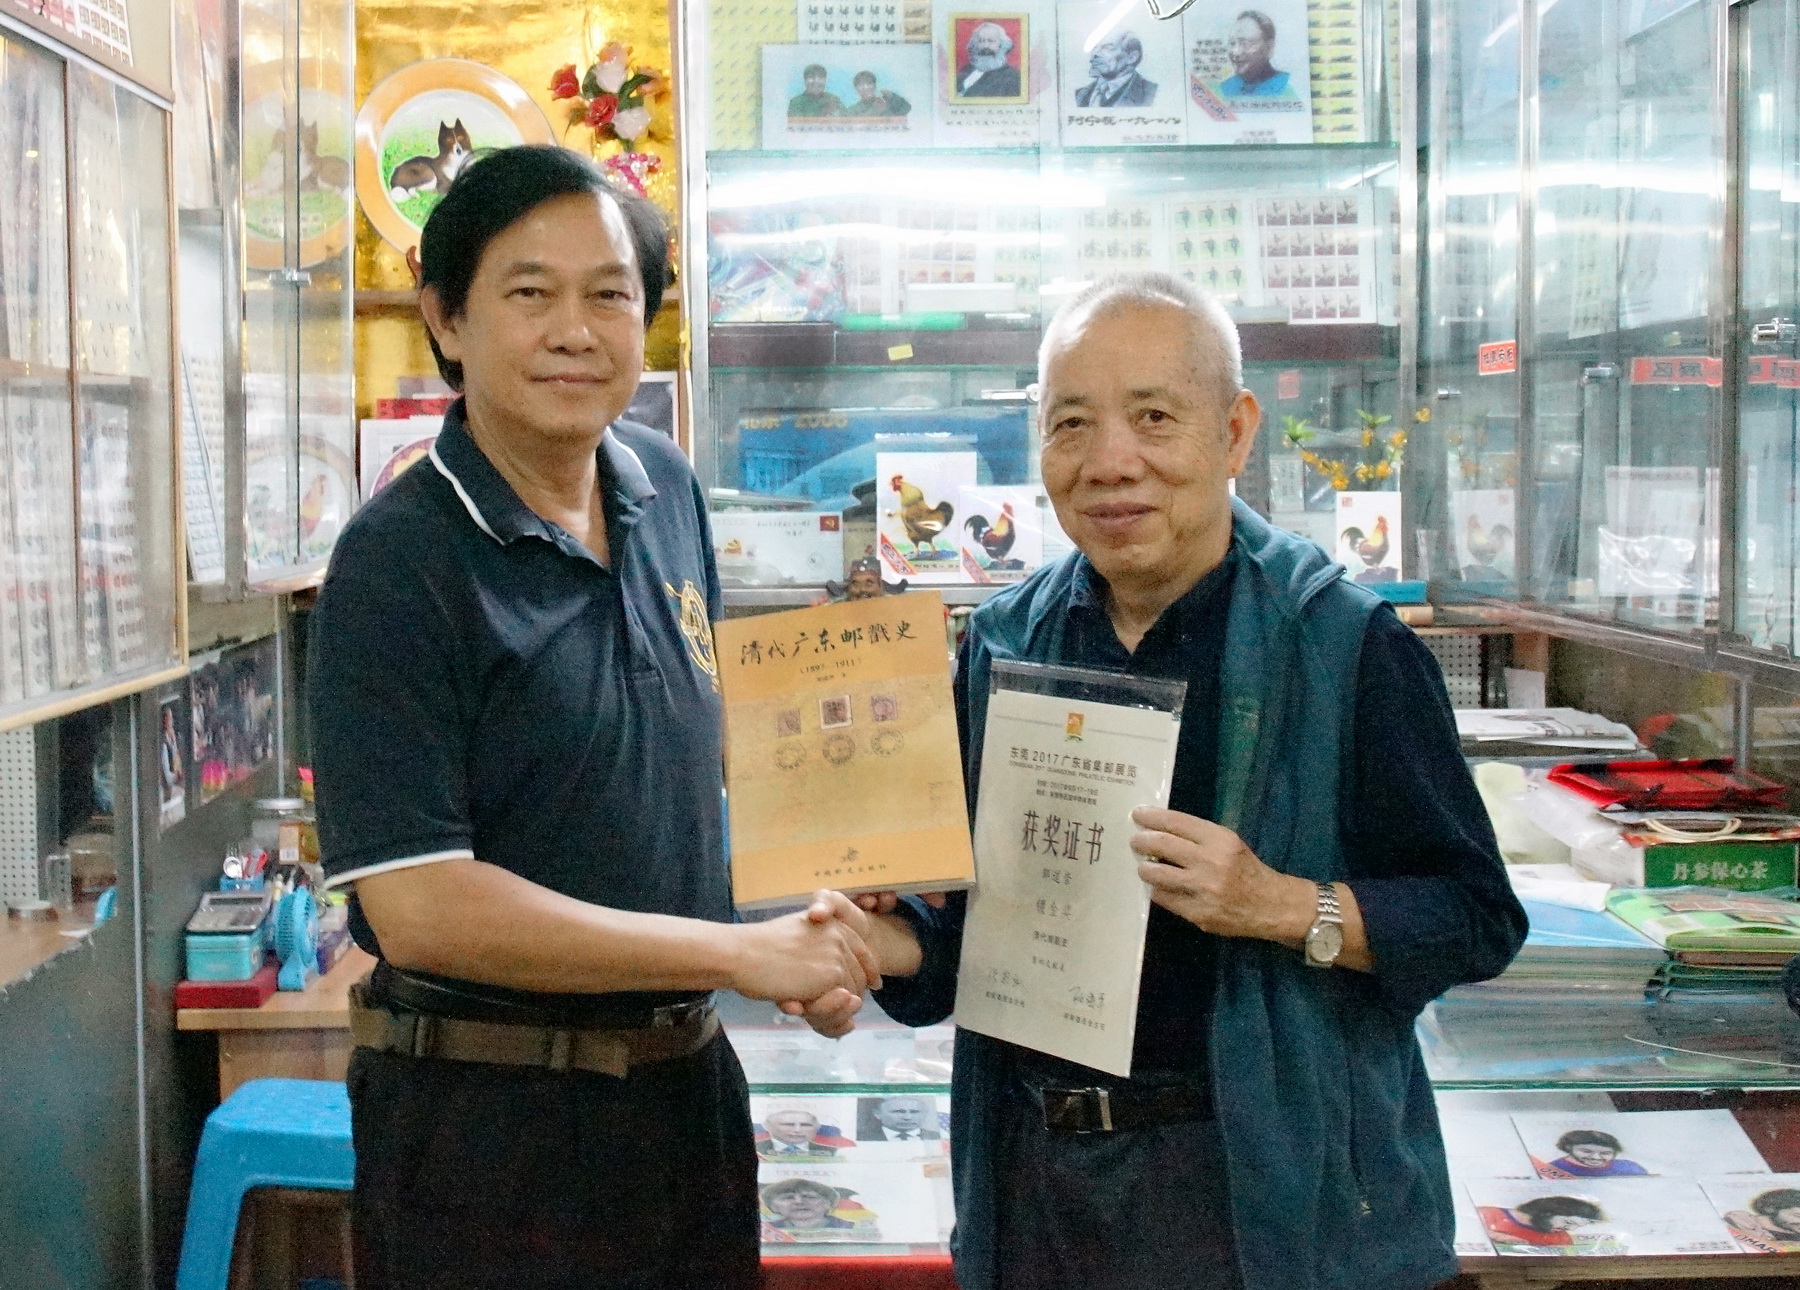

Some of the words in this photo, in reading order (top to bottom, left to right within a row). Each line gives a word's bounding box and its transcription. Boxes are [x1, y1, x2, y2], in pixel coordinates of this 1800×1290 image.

[741, 620, 918, 665] 清代广东邮戳史
[1022, 809, 1104, 865] 获奖证书
